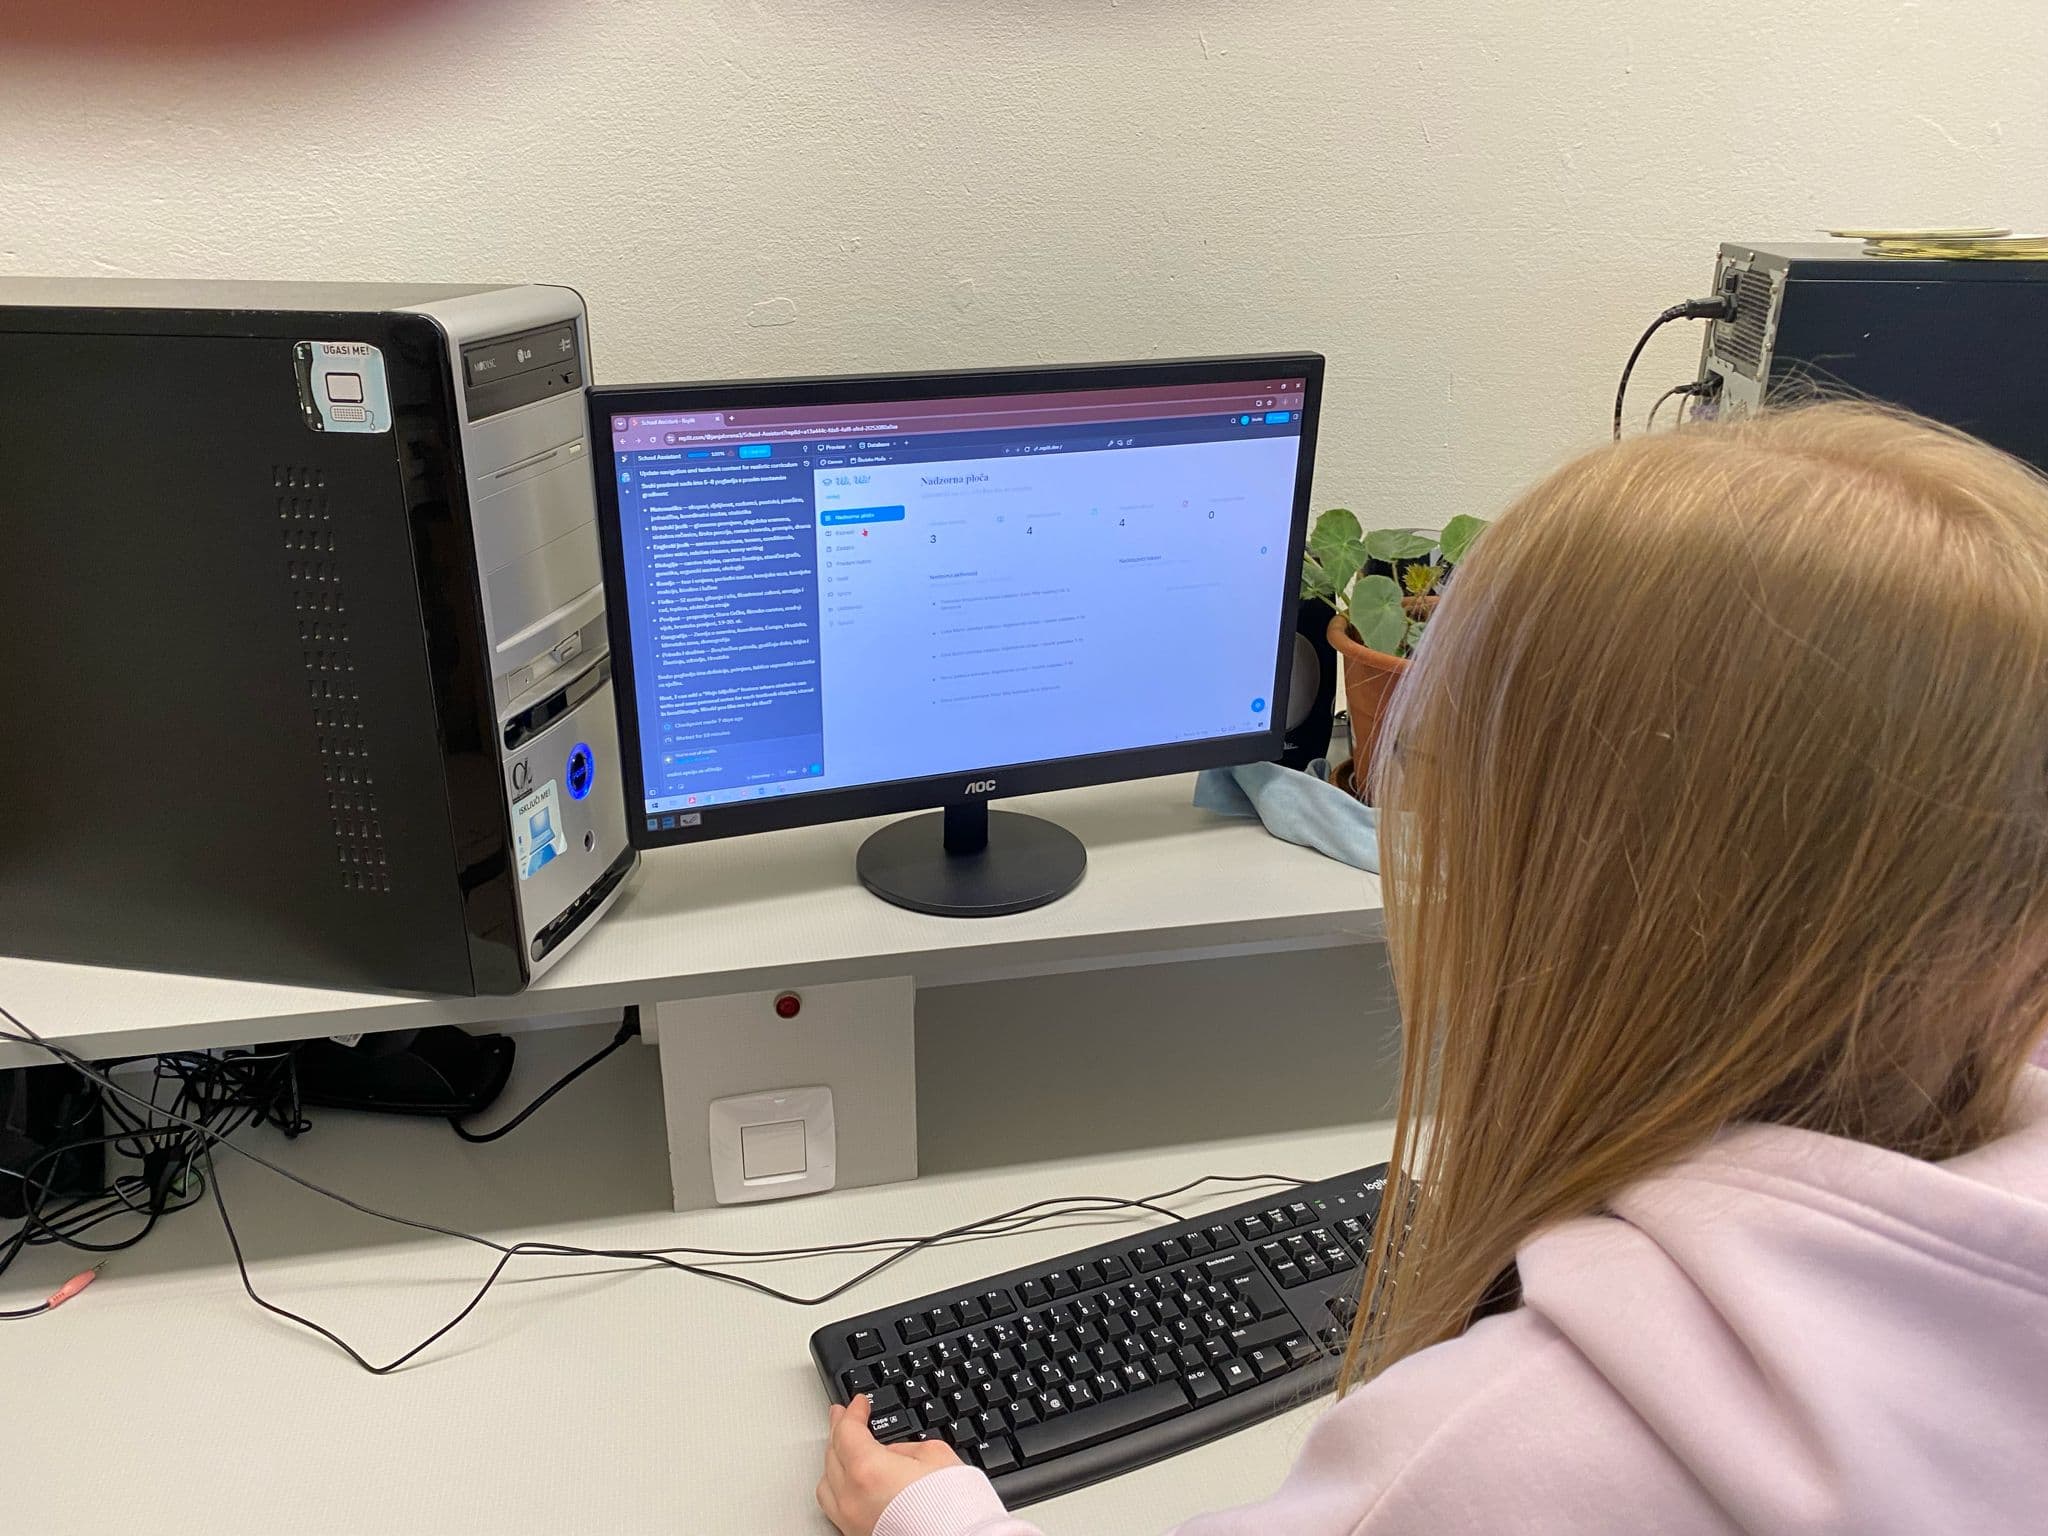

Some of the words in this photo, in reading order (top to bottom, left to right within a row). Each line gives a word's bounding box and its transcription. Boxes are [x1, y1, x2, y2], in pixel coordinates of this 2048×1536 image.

[323, 346, 350, 354] UGASI
[352, 346, 370, 355] ME!
[921, 476, 964, 485] Nadzorna
[966, 473, 988, 485] ploča
[1208, 511, 1215, 519] 0
[1119, 519, 1125, 527] 4
[1026, 526, 1033, 535] 4
[930, 535, 936, 543] 3
[964, 779, 996, 795] AOC
[519, 795, 540, 815] ISKLJUČI
[540, 788, 551, 800] ME!
[1076, 1326, 1084, 1334] U
[1151, 1330, 1159, 1338] L
[1049, 1334, 1058, 1342] Z
[1124, 1338, 1133, 1346] K
[1021, 1343, 1028, 1351] T
[1286, 1339, 1298, 1347] Ctrl
[1098, 1347, 1104, 1355] J
[993, 1352, 1001, 1360] R
[1068, 1355, 1078, 1364] H
[913, 1359, 920, 1367] 2
[964, 1361, 972, 1369] E
[934, 1370, 945, 1378] W
[1124, 1366, 1134, 1374] M
[1096, 1375, 1106, 1384] N
[905, 1380, 915, 1388] Q
[983, 1383, 991, 1391] D
[1068, 1385, 1077, 1393] B
[954, 1392, 961, 1400] S
[925, 1402, 933, 1410] A
[1011, 1403, 1019, 1411] C
[871, 1417, 889, 1425] Caps
[981, 1413, 989, 1421] X
[872, 1422, 889, 1431] Lock
[950, 1422, 958, 1430] Y
[979, 1442, 989, 1450] Alt
